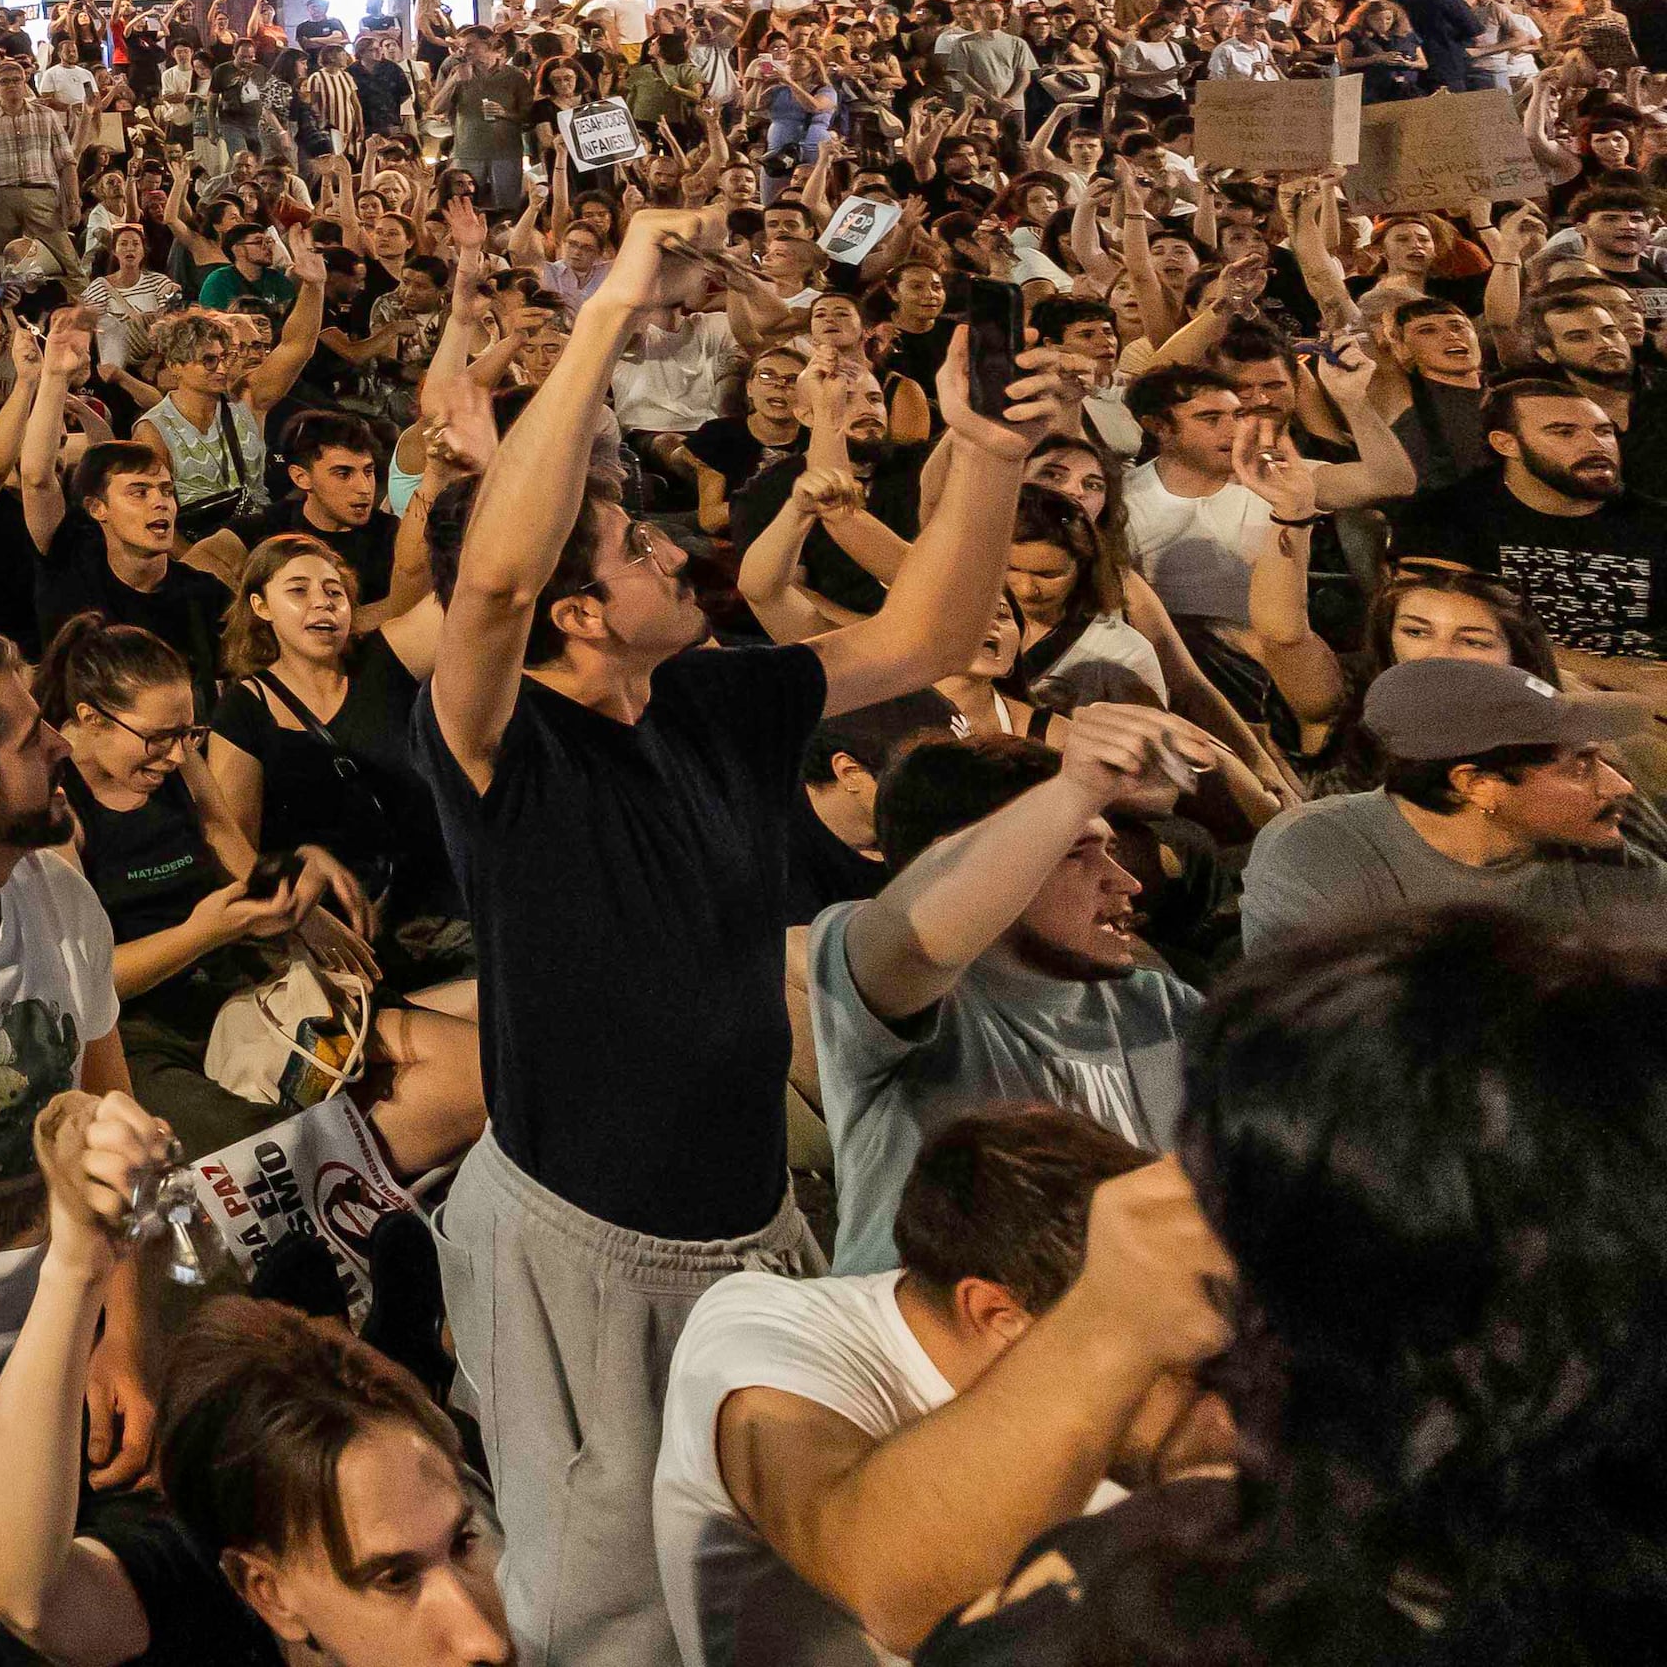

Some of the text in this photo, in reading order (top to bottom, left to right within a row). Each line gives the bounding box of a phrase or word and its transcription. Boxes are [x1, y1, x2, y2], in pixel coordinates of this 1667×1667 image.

[127, 855, 193, 880] MATADERO
[199, 1162, 251, 1219] PAZ
[243, 1170, 279, 1220] EL
